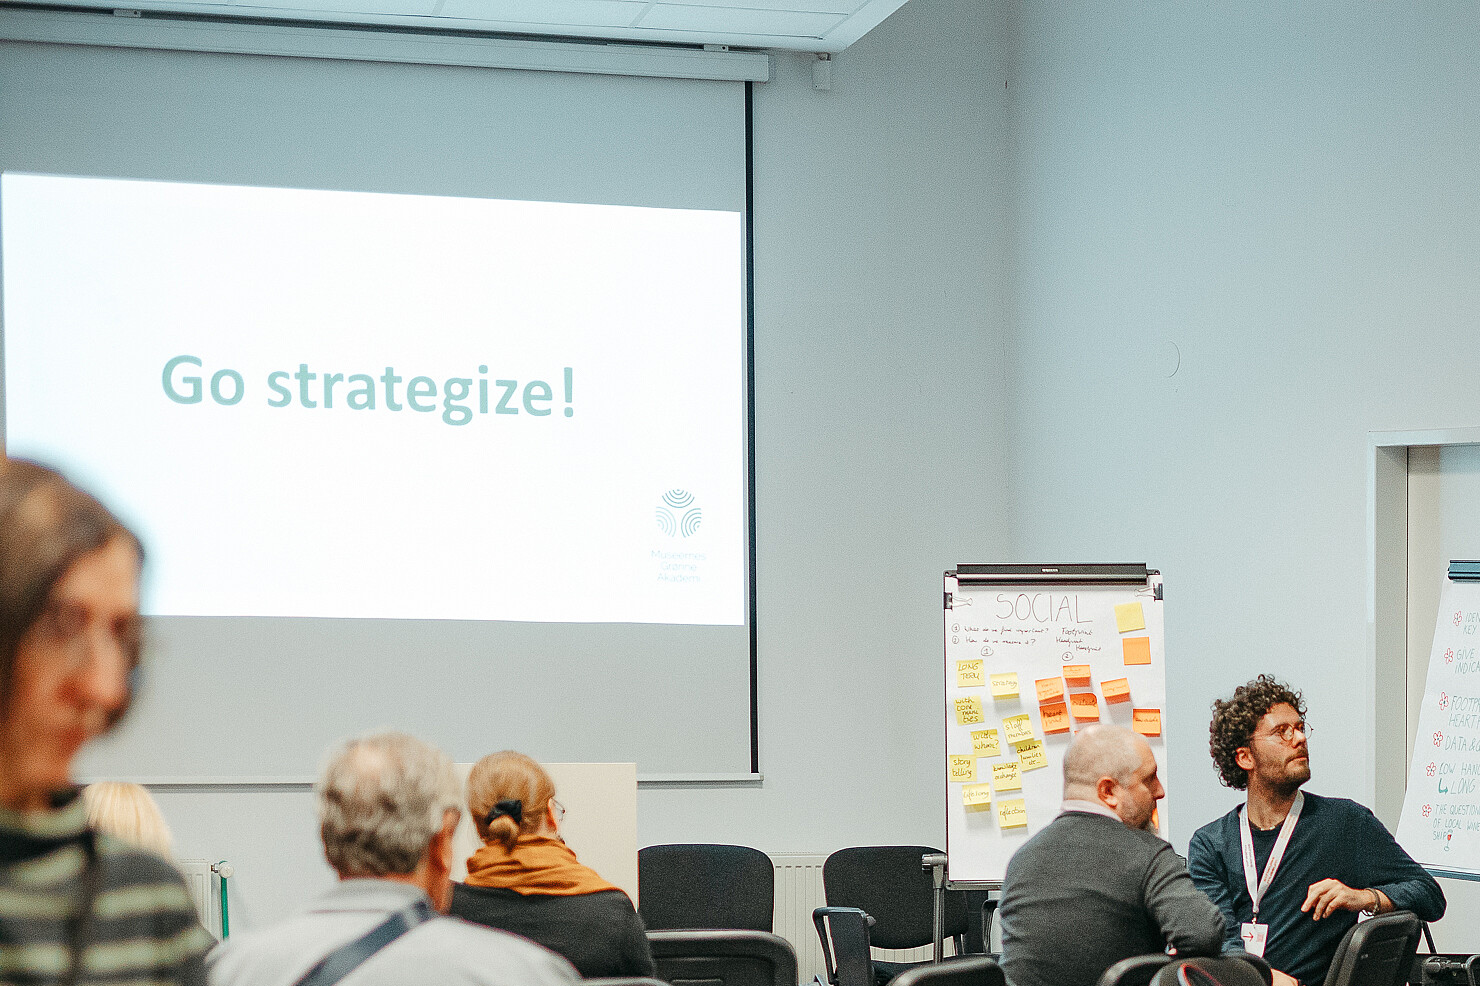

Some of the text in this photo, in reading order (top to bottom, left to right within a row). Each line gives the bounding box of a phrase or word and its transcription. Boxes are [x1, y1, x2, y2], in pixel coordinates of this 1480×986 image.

[161, 354, 574, 427] Go strategize!
[996, 593, 1093, 623] SOCIAL
[1463, 624, 1477, 635] KEY
[1456, 647, 1475, 660] GIVE
[958, 662, 979, 671] LONG
[1445, 735, 1467, 751] DATA
[1439, 761, 1456, 775] LOW
[1451, 777, 1475, 795] LONG
[1435, 804, 1447, 814] THE
